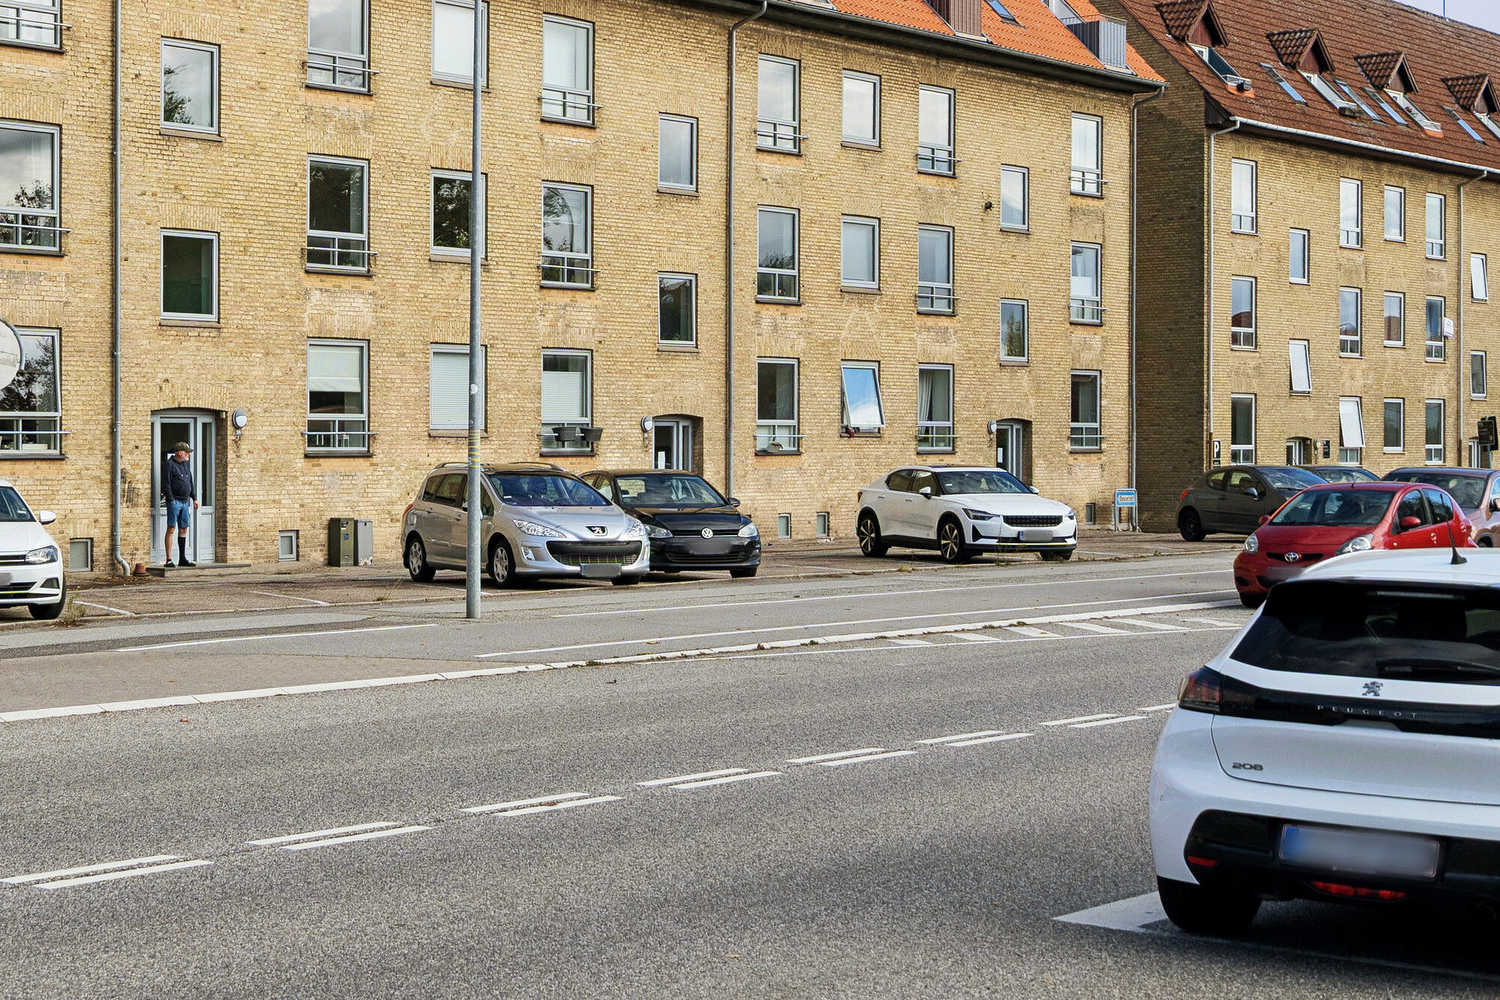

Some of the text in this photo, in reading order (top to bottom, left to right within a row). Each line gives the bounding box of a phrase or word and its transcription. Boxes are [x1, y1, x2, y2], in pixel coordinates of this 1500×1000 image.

[1214, 441, 1220, 458] P
[1317, 705, 1418, 718] PEUGEOT
[1232, 762, 1264, 771] 208
